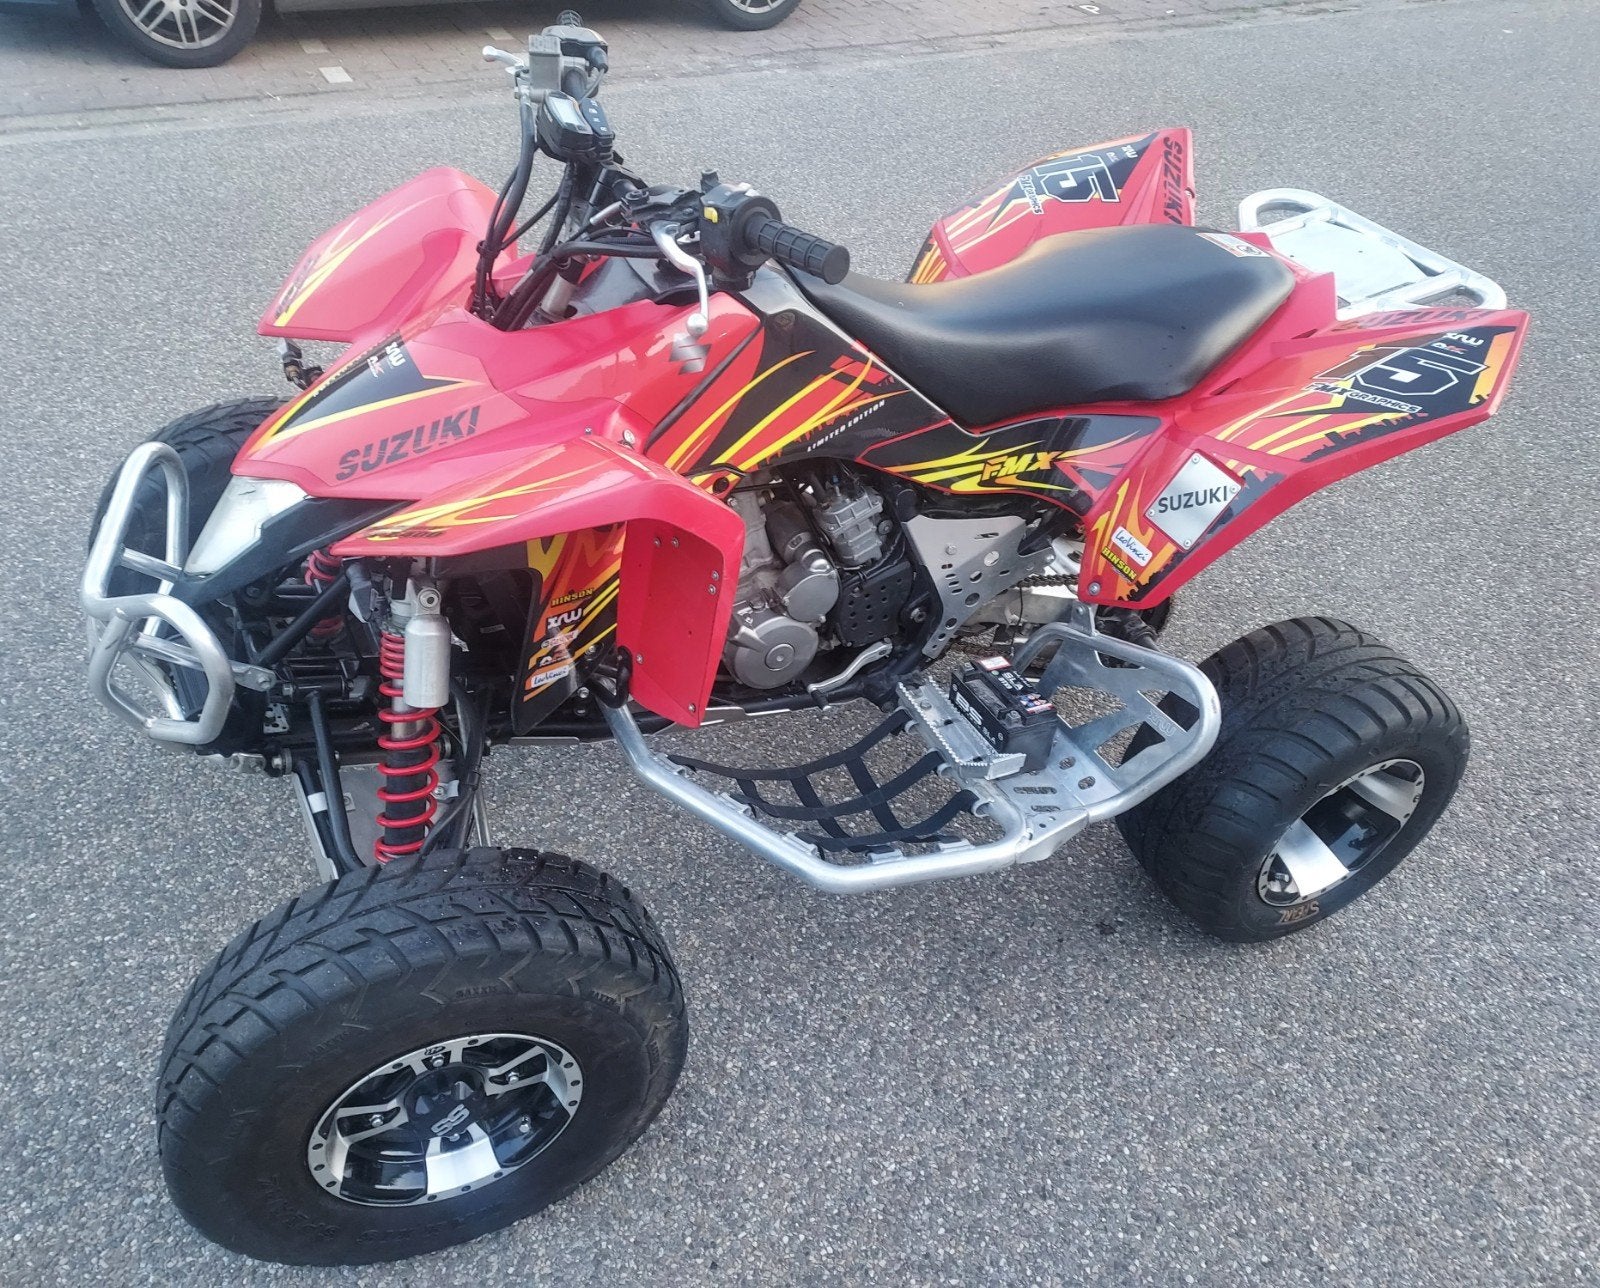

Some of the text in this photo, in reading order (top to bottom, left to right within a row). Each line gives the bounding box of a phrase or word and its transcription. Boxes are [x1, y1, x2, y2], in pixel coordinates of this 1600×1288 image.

[1163, 137, 1183, 225] SUZUKI
[807, 400, 885, 452] LIMITED EDITION
[335, 405, 482, 482] SUZUKI
[980, 450, 1064, 482] FMX
[1158, 485, 1228, 514] SUZUKI
[955, 692, 984, 726] BS
[430, 1103, 470, 1136] SS
